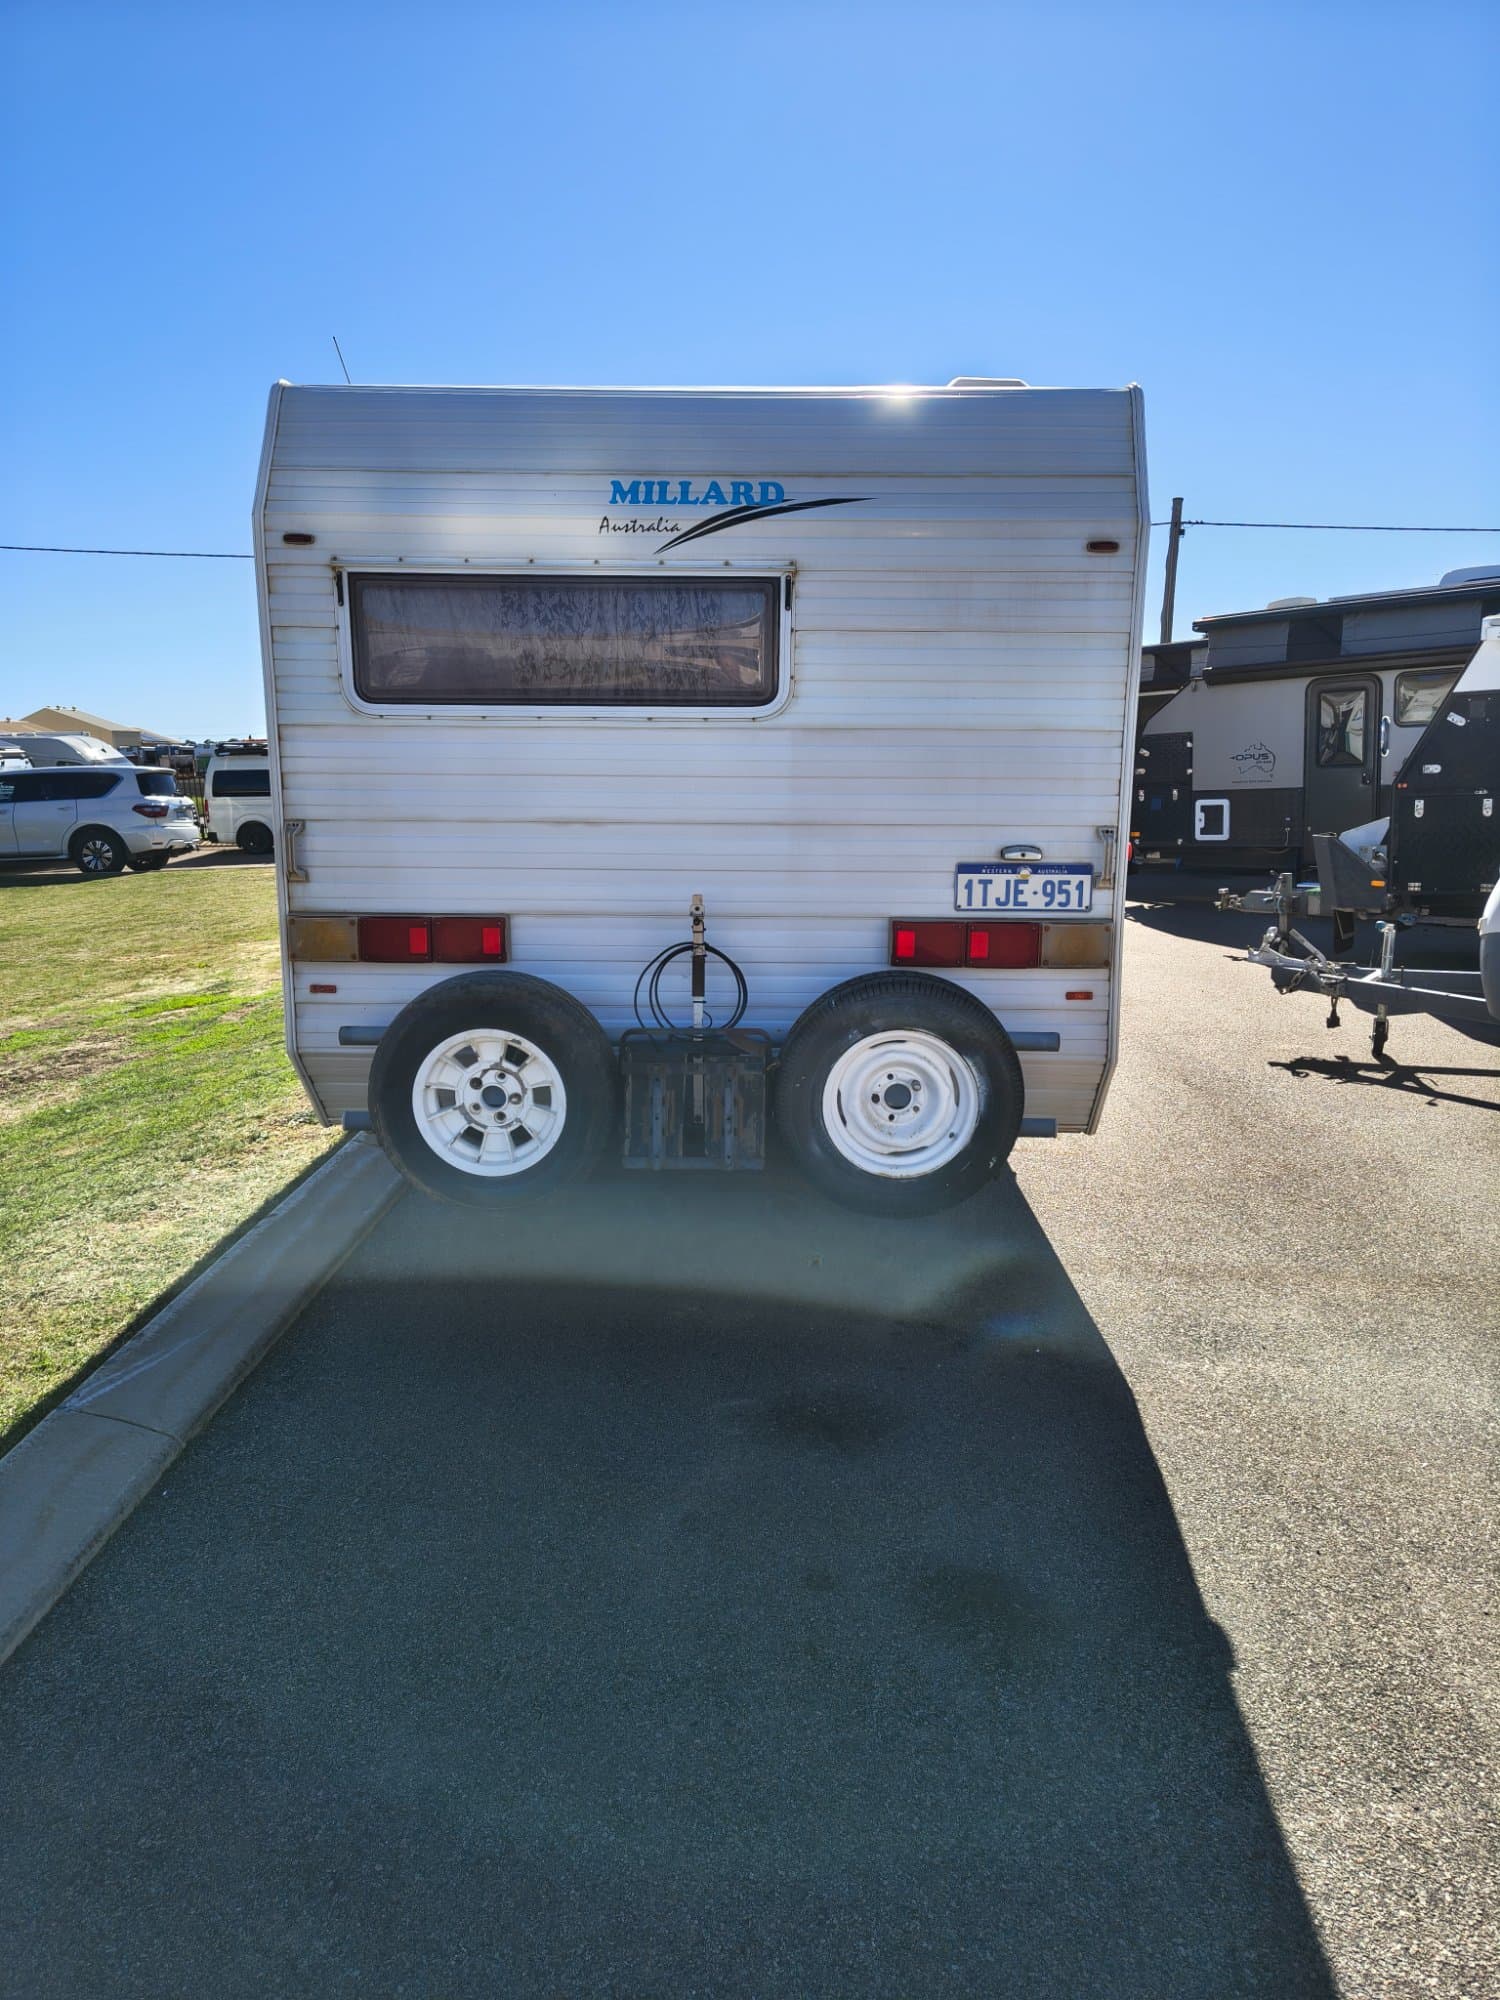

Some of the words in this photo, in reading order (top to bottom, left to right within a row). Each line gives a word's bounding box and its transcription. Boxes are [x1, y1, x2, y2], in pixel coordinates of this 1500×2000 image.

[609, 480, 784, 506] MILLARD
[599, 516, 681, 534] Australia
[1235, 753, 1269, 761] OPUS
